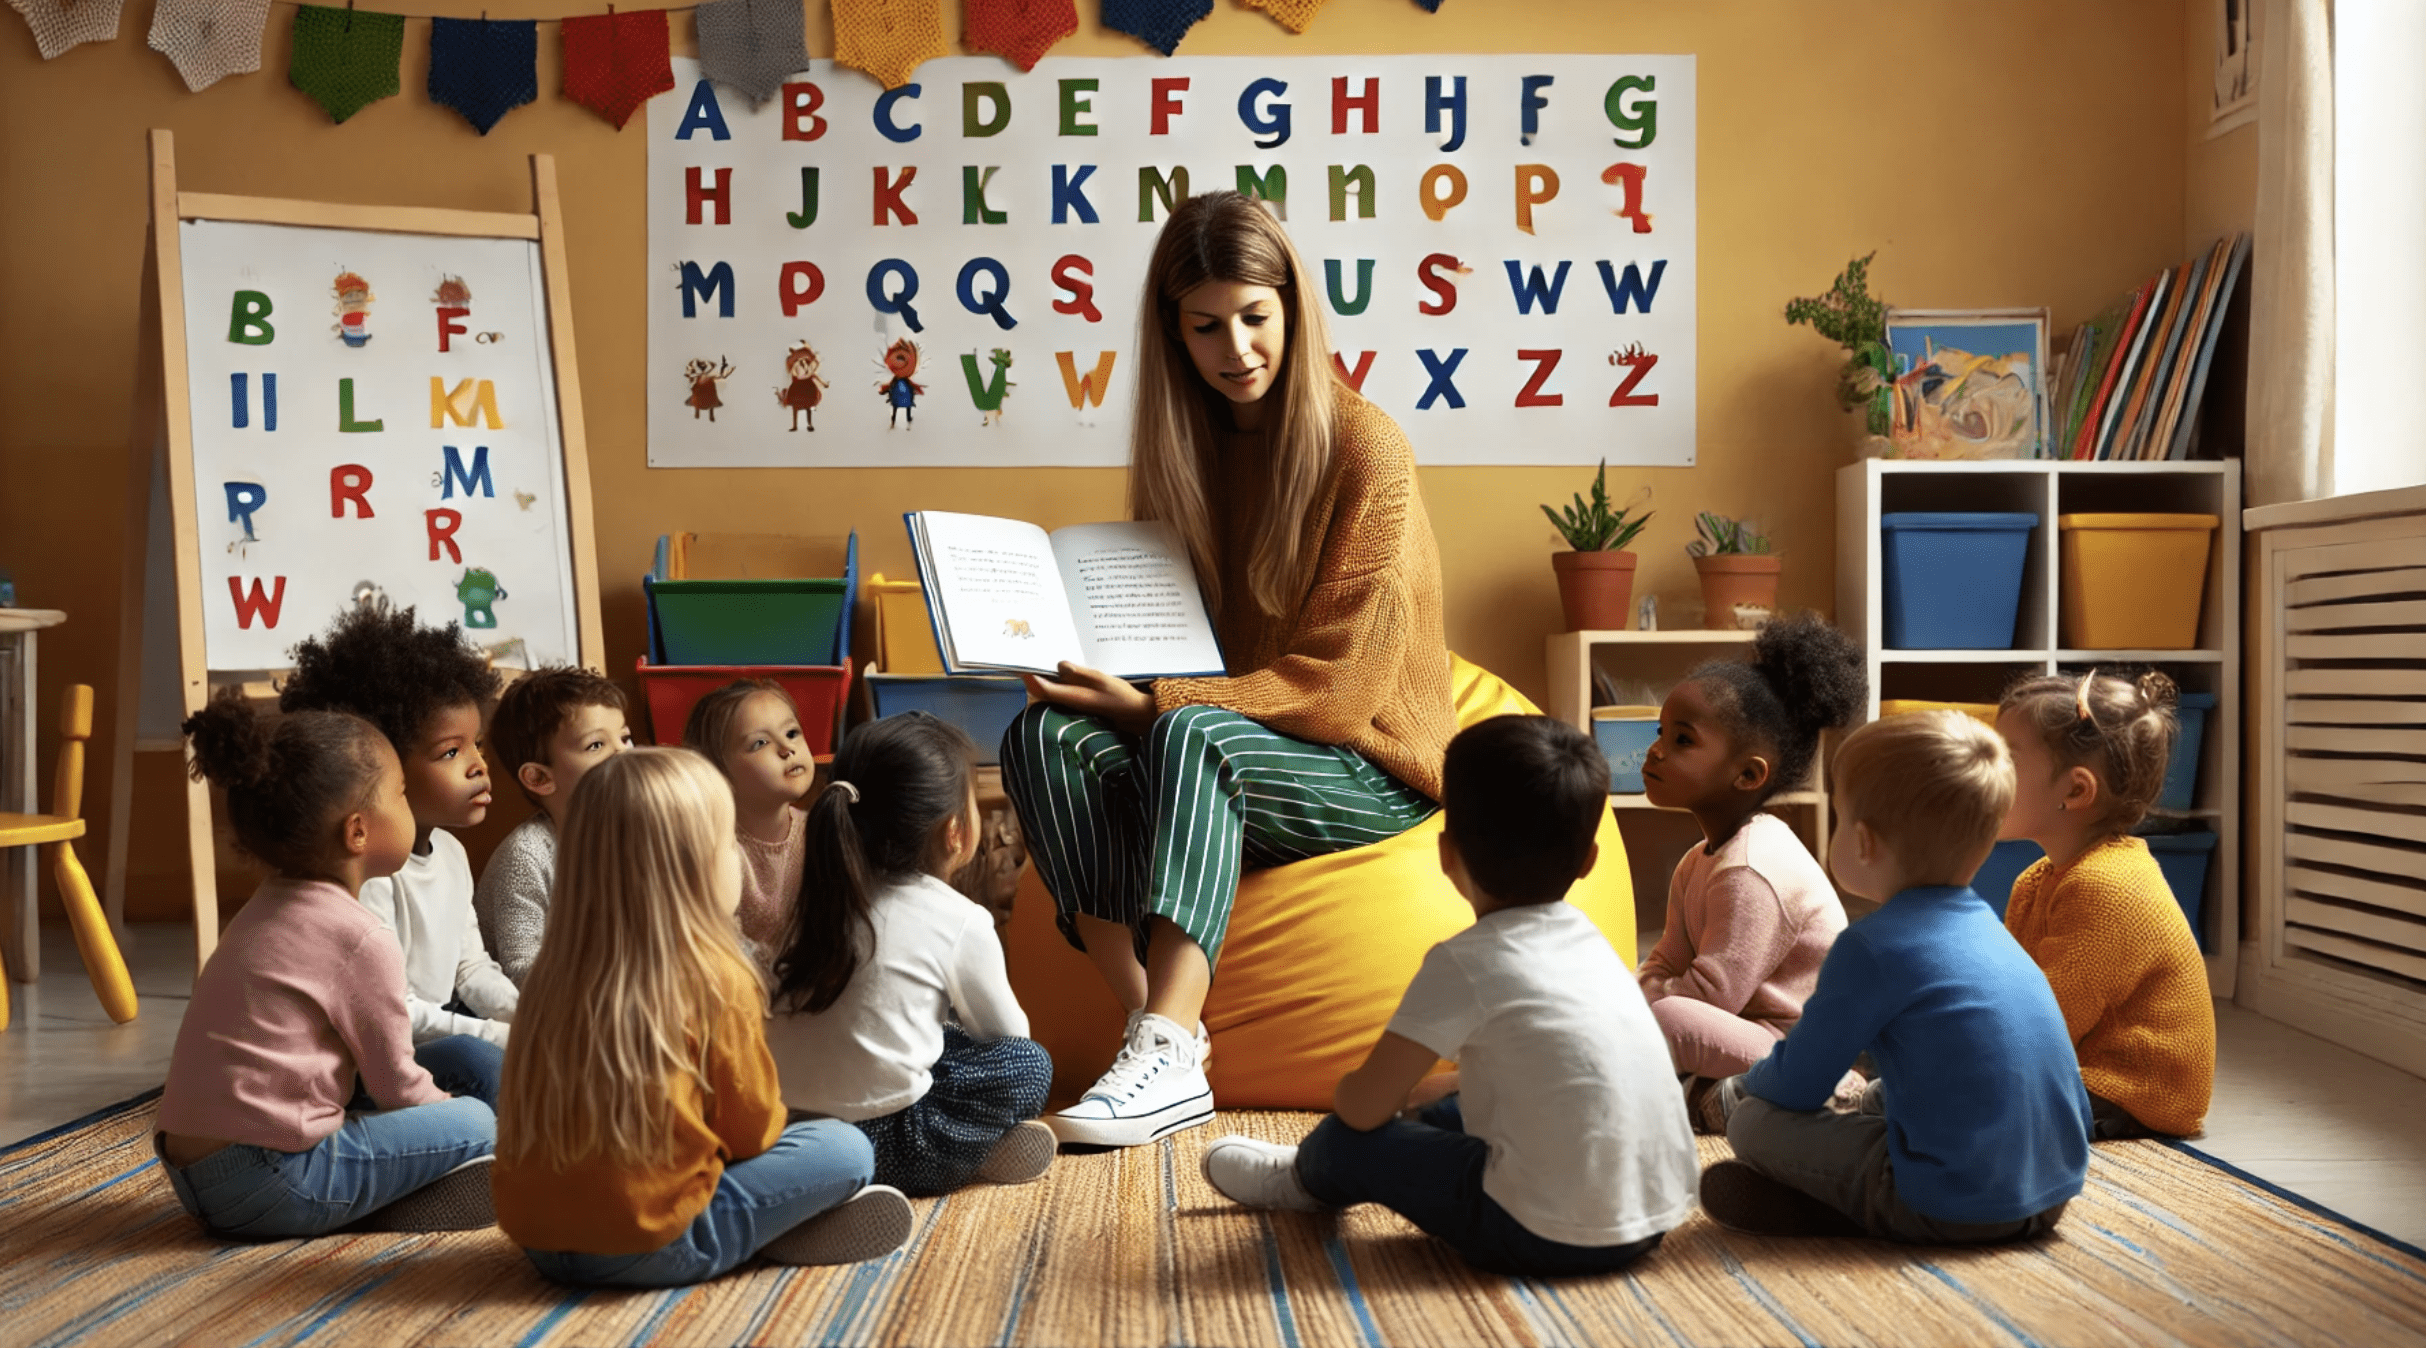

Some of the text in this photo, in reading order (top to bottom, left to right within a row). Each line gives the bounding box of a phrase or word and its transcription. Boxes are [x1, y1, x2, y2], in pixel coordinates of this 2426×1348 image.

[675, 79, 731, 141] A
[781, 81, 828, 142] B
[873, 83, 922, 143] C
[962, 81, 1012, 138] D
[1058, 78, 1099, 137] E
[1150, 77, 1190, 135] F
[1238, 77, 1292, 149] G
[1331, 76, 1380, 135] H
[1604, 75, 1657, 149] G
[685, 166, 733, 225] H
[786, 166, 819, 230] J
[873, 166, 919, 226] K
[1051, 164, 1100, 225] K
[228, 289, 471, 353] B F
[678, 260, 735, 318] M
[779, 260, 825, 317] P
[866, 258, 924, 333] Q
[956, 256, 1018, 330] Q
[1324, 258, 1376, 316] U
[1417, 253, 1472, 316] S
[1503, 259, 1572, 315] W
[1596, 259, 1668, 315] W
[338, 377, 384, 433] L
[1055, 350, 1117, 411] W
[1415, 348, 1469, 410] X
[1514, 349, 1563, 408] Z
[1608, 345, 1659, 408] Z
[330, 463, 375, 519] R
[441, 445, 495, 500] M
[424, 507, 462, 565] R
[227, 575, 287, 630] W
